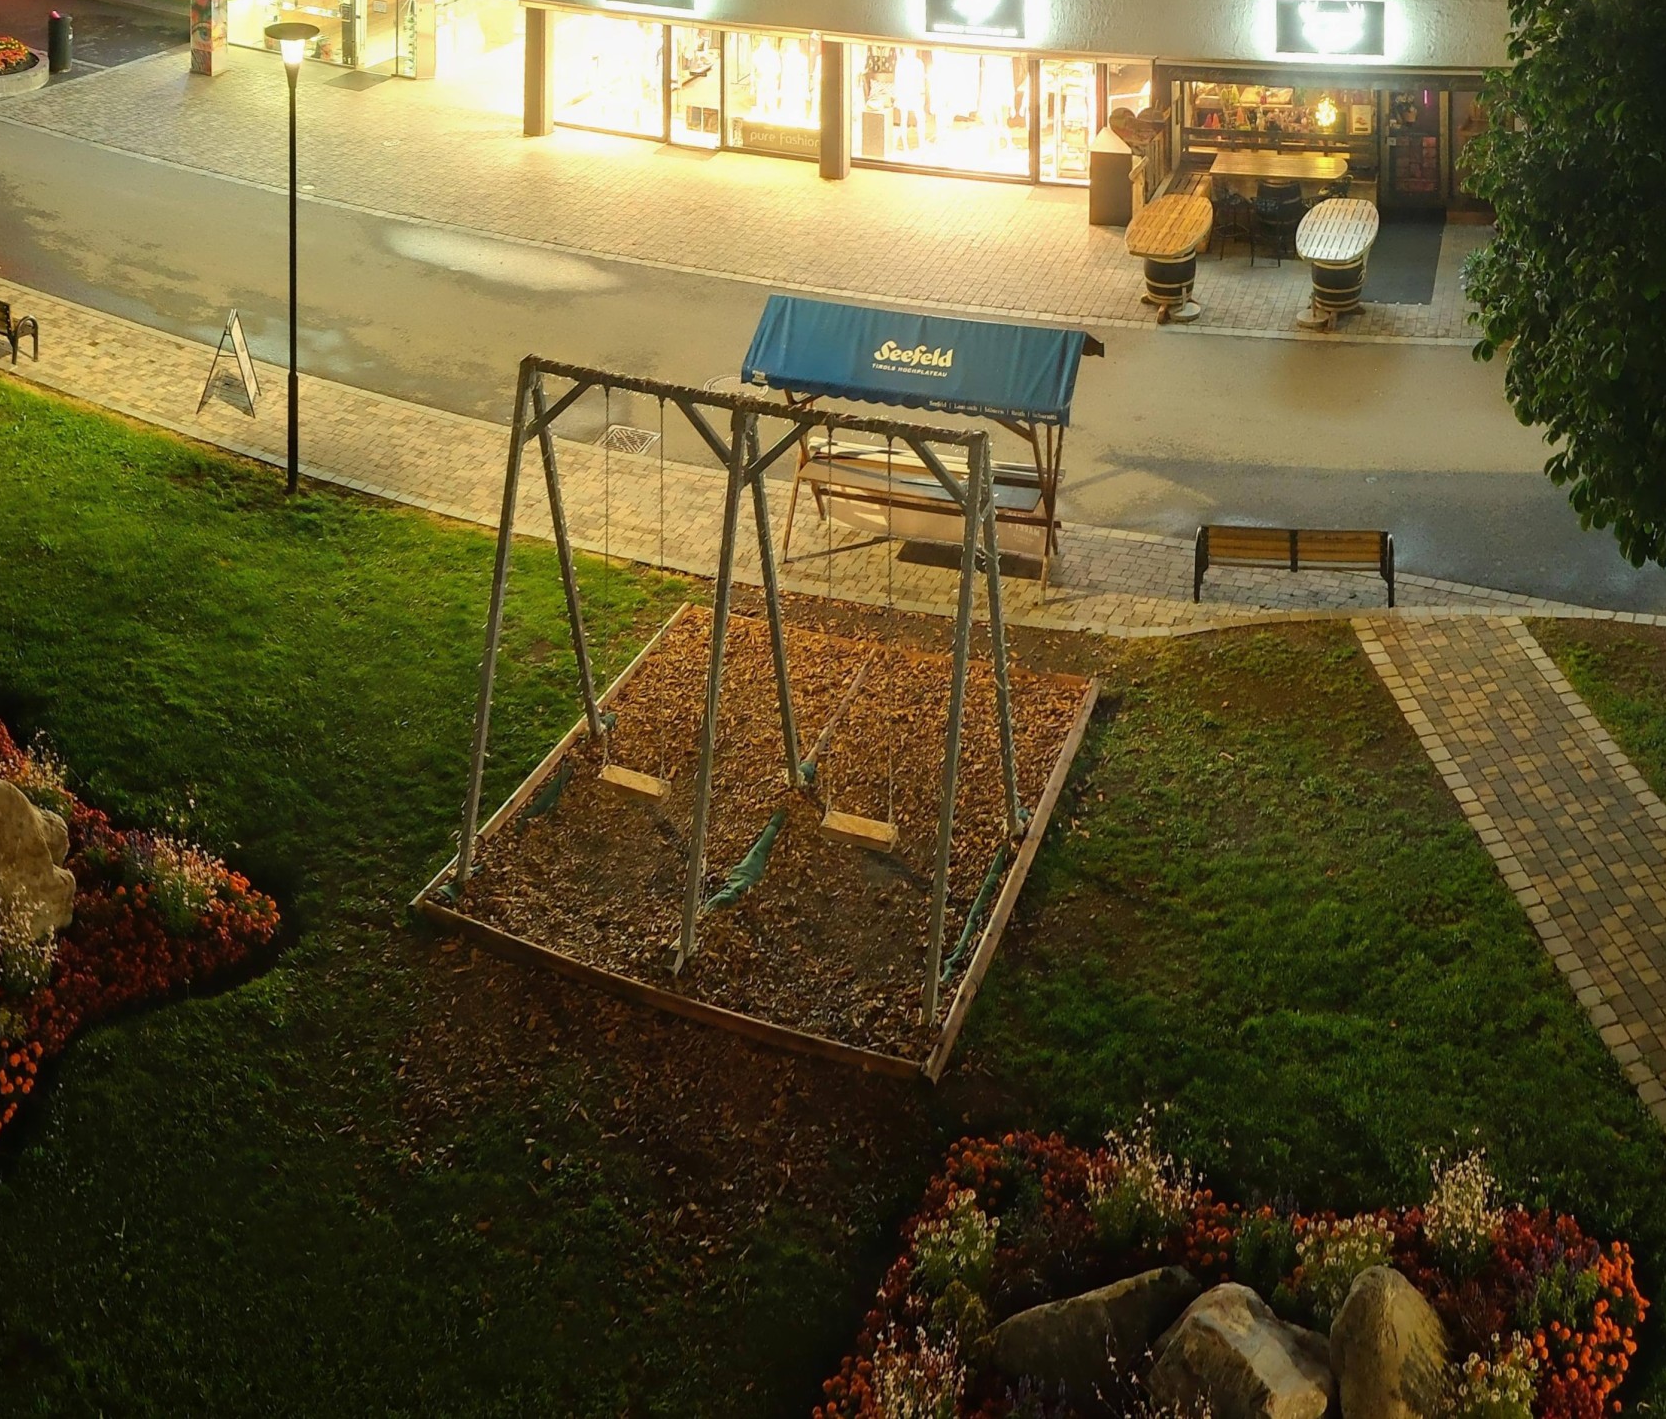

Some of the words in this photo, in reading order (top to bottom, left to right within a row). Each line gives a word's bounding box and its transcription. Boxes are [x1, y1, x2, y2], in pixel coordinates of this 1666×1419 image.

[873, 340, 954, 368] Seefeld
[872, 362, 896, 372] TIROLS
[897, 367, 948, 378] HOCHPLATEAU
